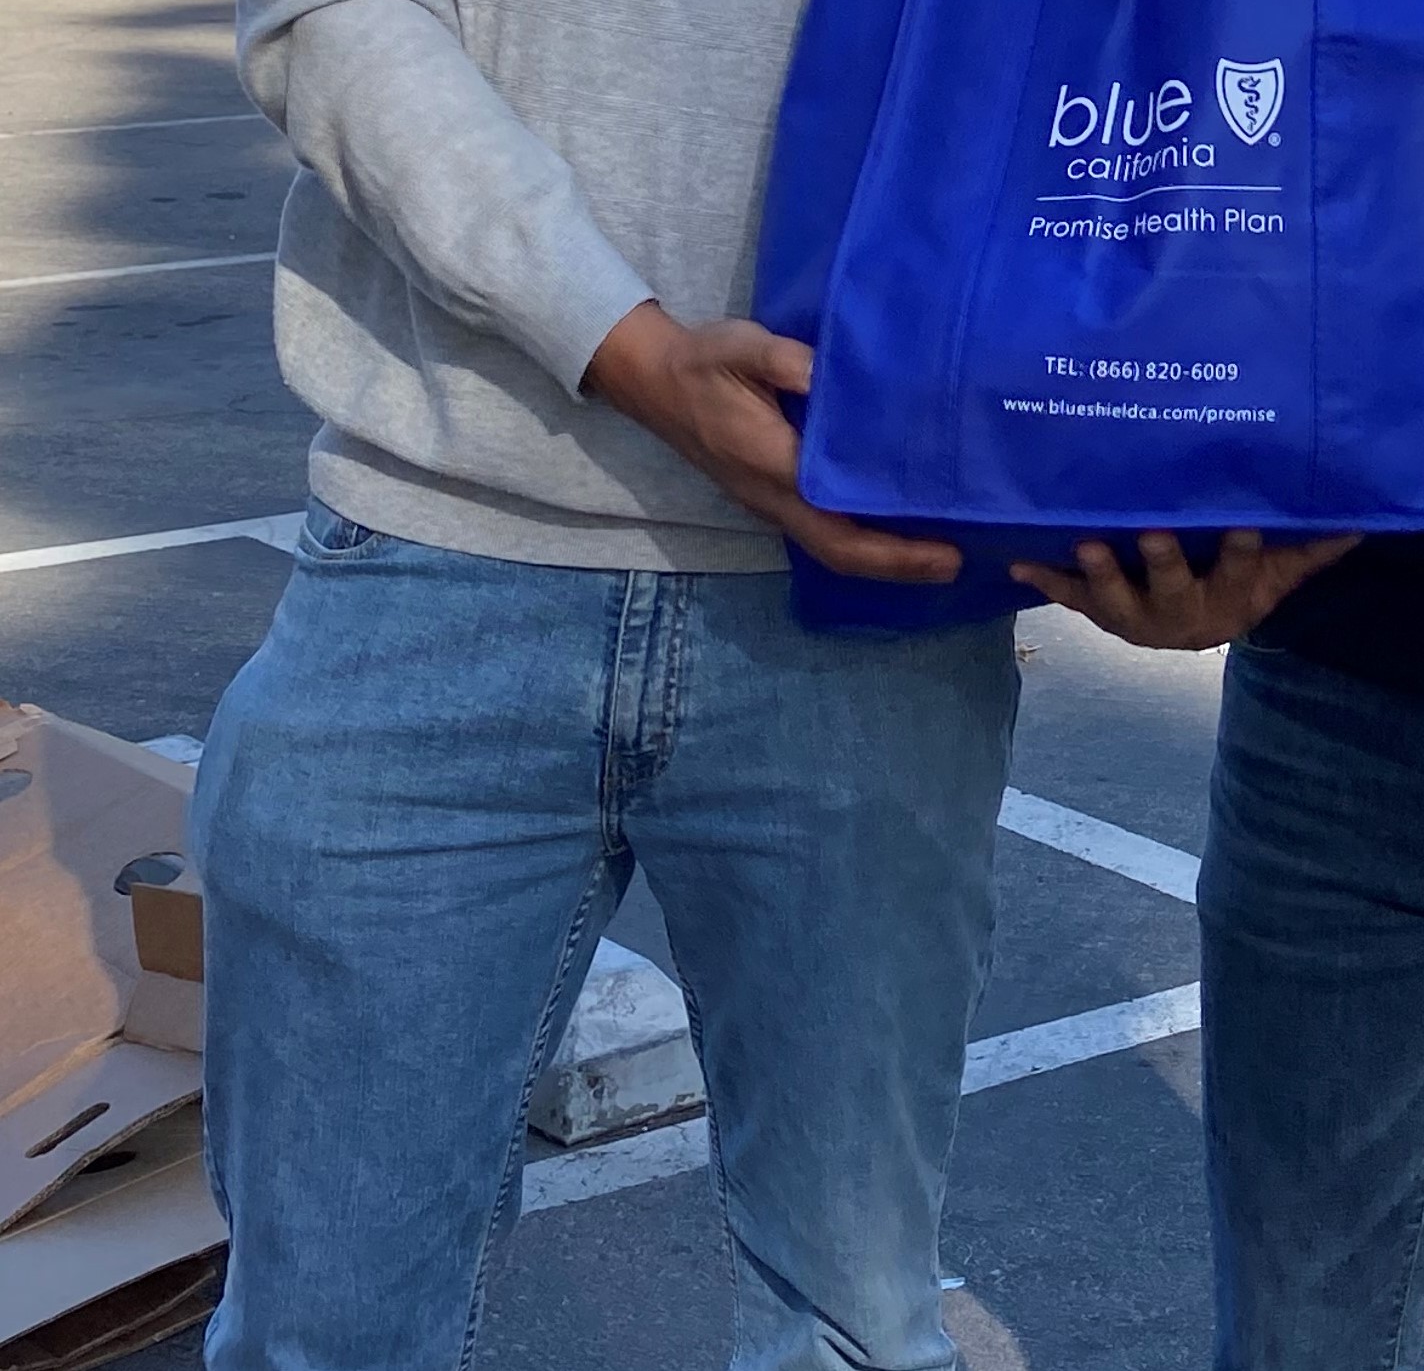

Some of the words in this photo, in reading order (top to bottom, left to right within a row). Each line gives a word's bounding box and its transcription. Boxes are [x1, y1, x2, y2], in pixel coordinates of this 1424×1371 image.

[1048, 79, 1193, 148] blue
[1067, 137, 1215, 182] california
[1028, 215, 1129, 241] Promise
[1134, 206, 1216, 236] Health
[1224, 208, 1284, 233] Plan
[1089, 359, 1140, 381] (866)
[1145, 362, 1239, 381] 820-6009
[1003, 398, 1277, 424] www.blueshieldca.com/promise
